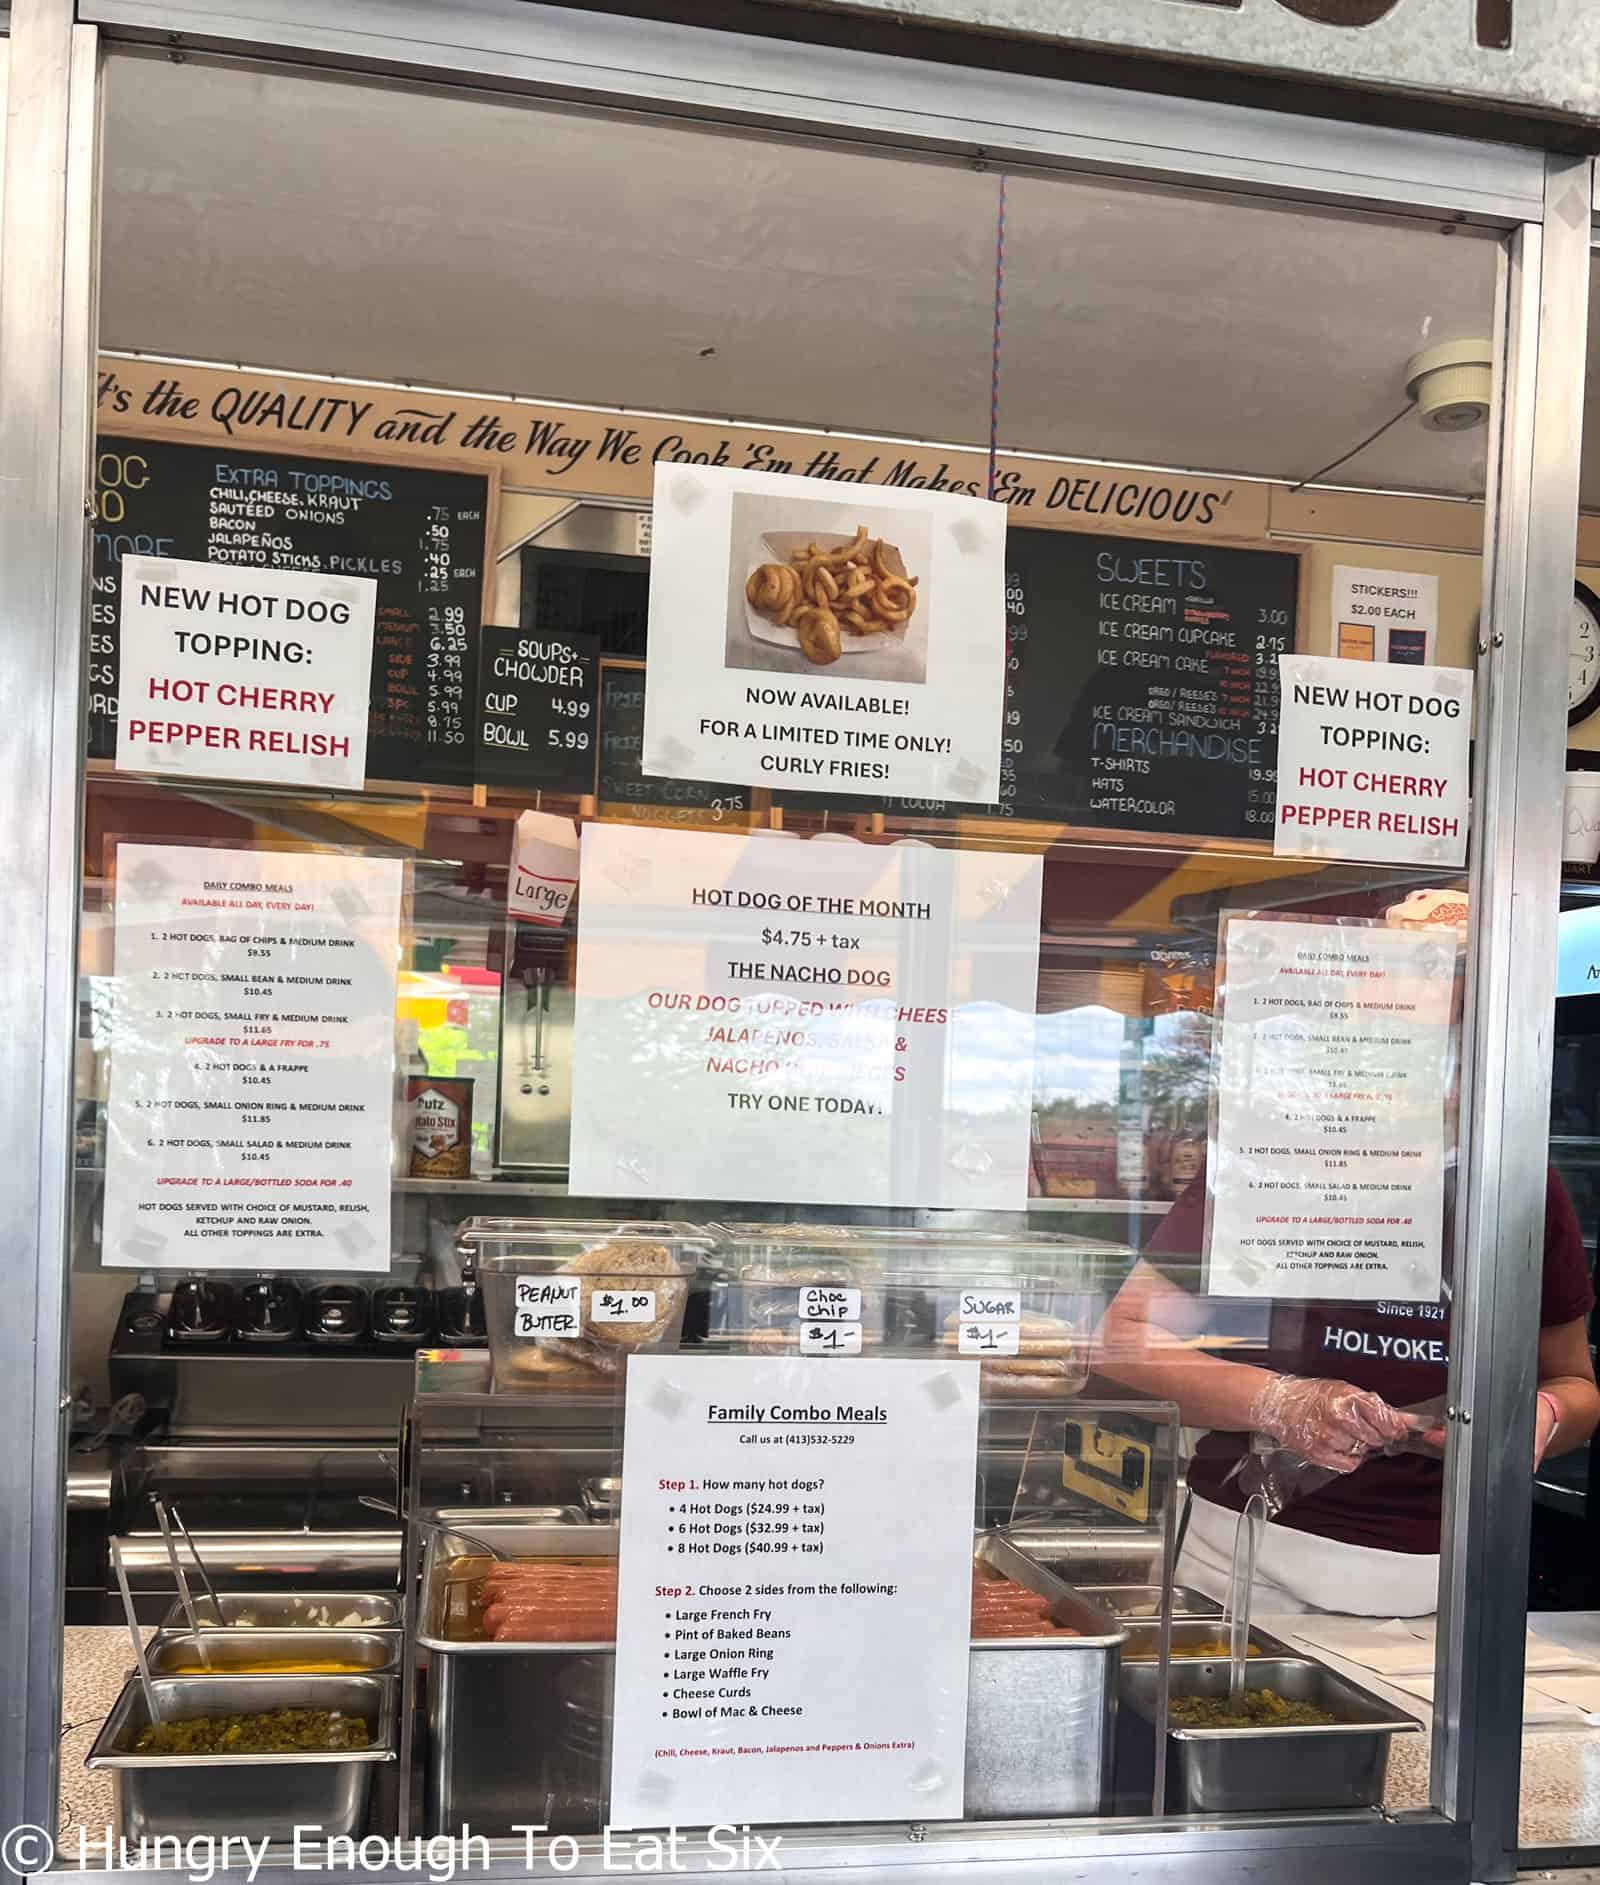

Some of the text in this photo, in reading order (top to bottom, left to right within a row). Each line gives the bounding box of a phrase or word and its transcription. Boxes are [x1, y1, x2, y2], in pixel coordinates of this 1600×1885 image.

[143, 380, 199, 419] the
[211, 388, 373, 436] QUALITY
[374, 409, 457, 447] and
[460, 416, 518, 453] the
[524, 420, 592, 475] Way
[597, 428, 642, 465] We
[882, 462, 979, 497] Makes
[215, 464, 393, 501] EXTRA TOPPINGS
[209, 500, 345, 525] SAUTÉED ONIONS
[306, 493, 363, 511] KRAUT
[209, 516, 256, 532] BACON
[207, 531, 294, 551] JALAPEÑOS
[207, 546, 267, 563] POTATO
[329, 555, 403, 576] PICKLES
[1096, 551, 1207, 590] SWEETS
[140, 583, 211, 611] NEW
[218, 591, 279, 618] HOT
[285, 598, 350, 624] DOG
[1351, 583, 1418, 599] STICKERS!!!
[1100, 593, 1121, 612] ICE
[1122, 594, 1177, 616] CREAM
[1350, 603, 1416, 620] $2.00 EACH
[1099, 620, 1120, 638] ICE
[1123, 623, 1175, 642] CREAM
[1177, 627, 1238, 648] CUPCAKE
[173, 630, 312, 664] TOPPING:
[493, 657, 584, 689] CHOWDER
[1097, 649, 1119, 667] ICE
[1123, 650, 1171, 669] CREAM
[1175, 656, 1209, 675] CAKE
[148, 677, 335, 714] HOT CHERRY
[485, 692, 590, 719] CUP 4.99
[745, 687, 909, 715] NOW AVAILABLE!
[1293, 684, 1460, 718] NEW HOT DOG
[129, 719, 240, 749] PEPPER
[248, 729, 349, 758] RELISH
[483, 722, 529, 748] BOWL
[548, 729, 589, 750] 5.99
[699, 718, 951, 753] FOR A LIMITED TIME ONLY!
[1092, 722, 1263, 765] MERCHANDISE
[1319, 725, 1429, 754] TOPPING:
[760, 754, 889, 779] CURLY FRIES!
[1090, 756, 1151, 774] T-SHIRTS
[1092, 777, 1125, 793] HATS
[1299, 766, 1447, 798] HOT CHERRY
[1090, 797, 1176, 816] WATERCOLOR
[1281, 804, 1458, 837] PEPPER RELISH
[515, 874, 569, 911] Large
[692, 887, 930, 920] HOT DOG OF THE MONTH
[761, 926, 860, 950] $4.75 + tax
[727, 961, 891, 987] THE NACHO DOG
[647, 992, 741, 1013] OUR DOG
[706, 1056, 779, 1075] NACHO
[727, 1092, 763, 1110] TRY
[767, 1095, 809, 1112] ONE
[137, 1202, 369, 1213] HOT DOGS SERVED WITH CHOICE OF MUSTARD, RELISH,
[183, 1228, 323, 1237] ALL OTHER TOPPINGS ARE EXTRA.
[518, 1284, 578, 1305] PEANUT
[962, 1296, 1016, 1315] SUGAR
[520, 1312, 577, 1332] BUTTER
[1376, 1300, 1445, 1321] Since 1921
[707, 1403, 888, 1422] Family Combo Meals
[738, 1433, 855, 1446] Call us at (413)532-5229
[658, 1478, 824, 1492] Step 1. How many hot dogs?
[679, 1501, 824, 1516] 4 Hot Dogs ($24.99 + tax)
[672, 1685, 751, 1699] Cheese Curds
